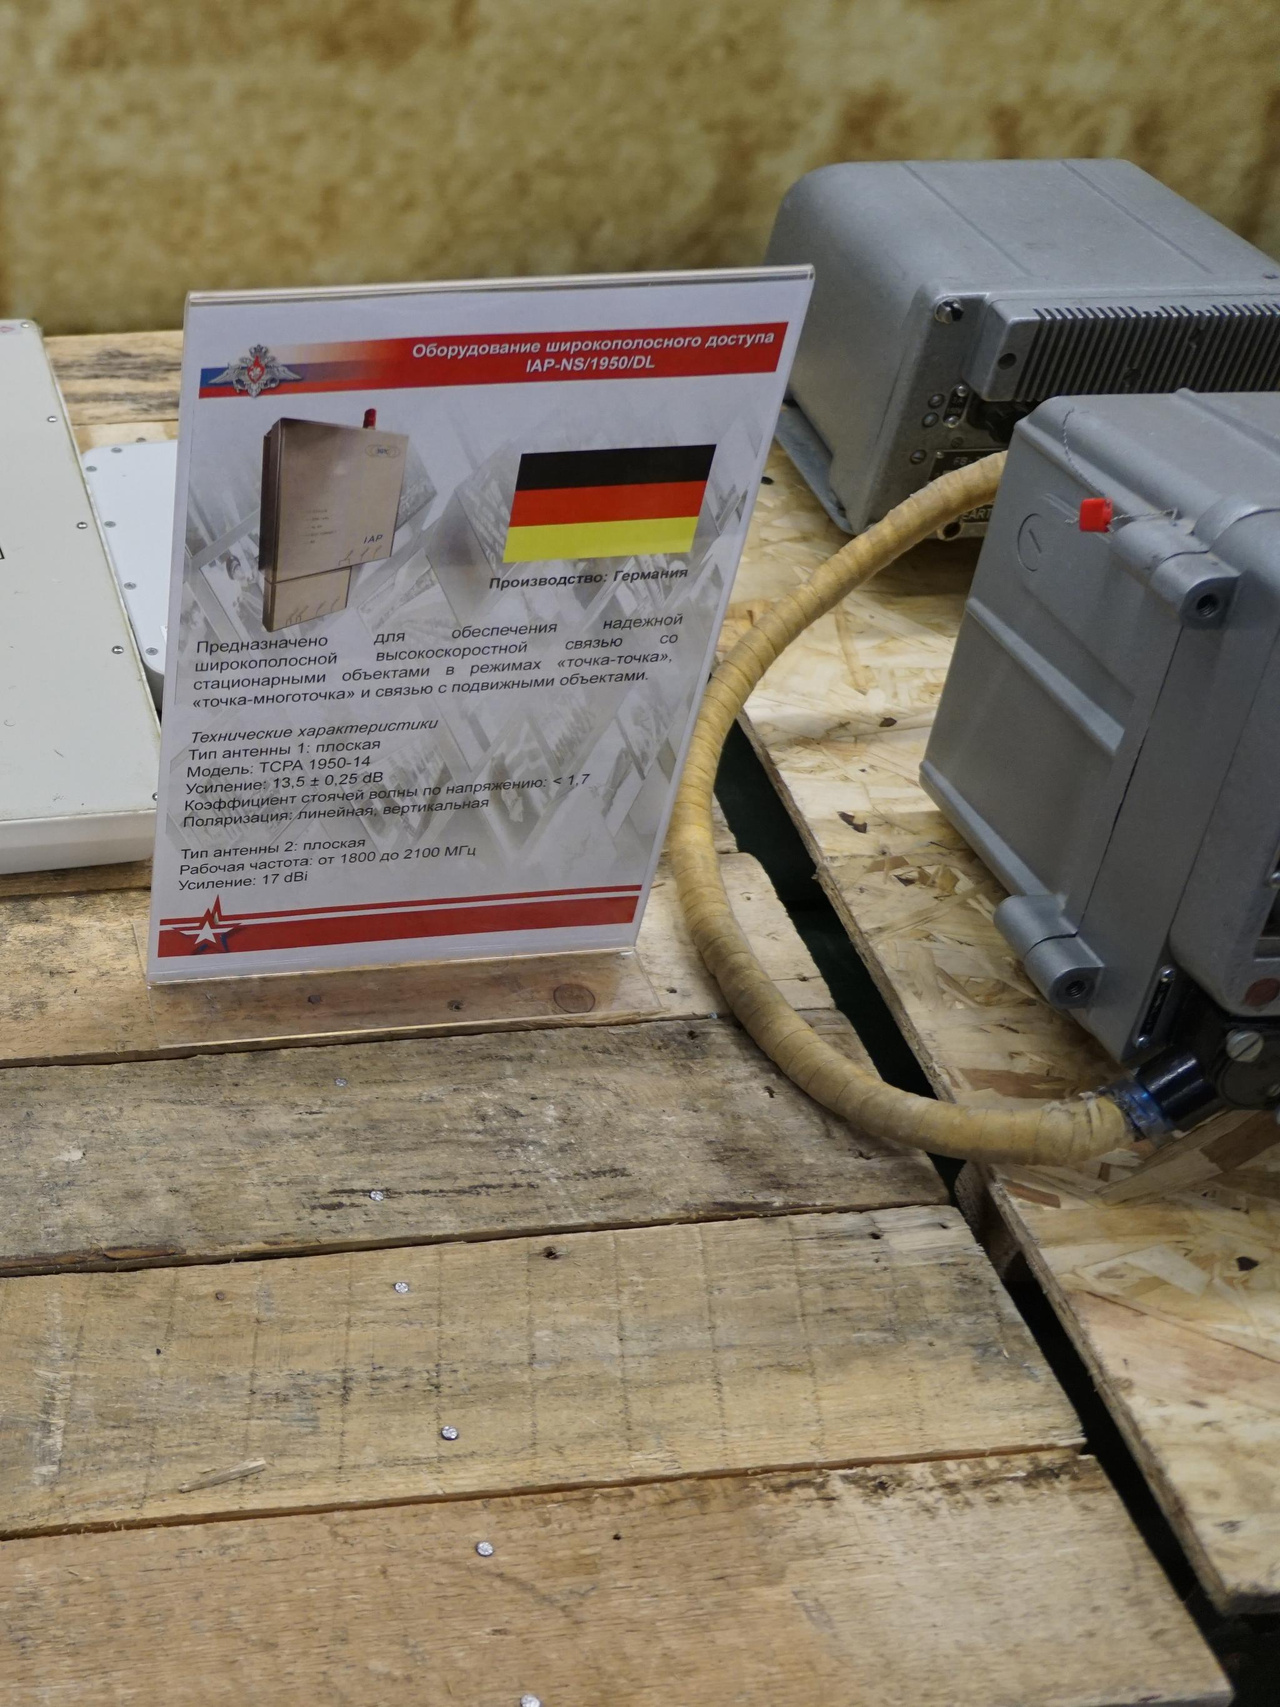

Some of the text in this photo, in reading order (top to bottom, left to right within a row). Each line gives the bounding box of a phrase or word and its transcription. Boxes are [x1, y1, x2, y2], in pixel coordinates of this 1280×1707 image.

[412, 331, 775, 360] Оборудование широкополосного доступа
[526, 355, 656, 374] IAP-NS/1950/DL
[489, 568, 689, 592] Производство: Германия
[196, 613, 684, 656] Предназначено для обеспечения надежной
[195, 633, 679, 674] широкополосной высокоскоростной связью со
[193, 652, 673, 691] стационарными объектами в режимах «точка-точка»,
[192, 670, 649, 709] «точка-многоточка» и связью с подвижными объектами.
[191, 718, 439, 744] Технические характеристики
[189, 739, 381, 762] Тип антенны 1: плоская
[186, 764, 254, 779] Модель:
[309, 755, 371, 771] 1950-14
[184, 795, 297, 812] Коэффициент
[301, 789, 365, 804] стоячей
[369, 787, 418, 800] волны
[423, 785, 441, 798] по
[445, 776, 548, 795] напряжению:
[567, 773, 591, 788] 1,7
[186, 780, 267, 795] Усиление:
[273, 776, 306, 790] 13,5
[324, 773, 358, 787] 0,25
[362, 771, 384, 784] dB
[183, 799, 489, 828] Поляризация: линейная, вертикальная
[179, 845, 477, 876] Рабочая частота: от 1800 до 2100 МГц
[180, 839, 366, 861] Тип антенны 2: плоская
[178, 870, 308, 891] Усиление: 17 dBi
